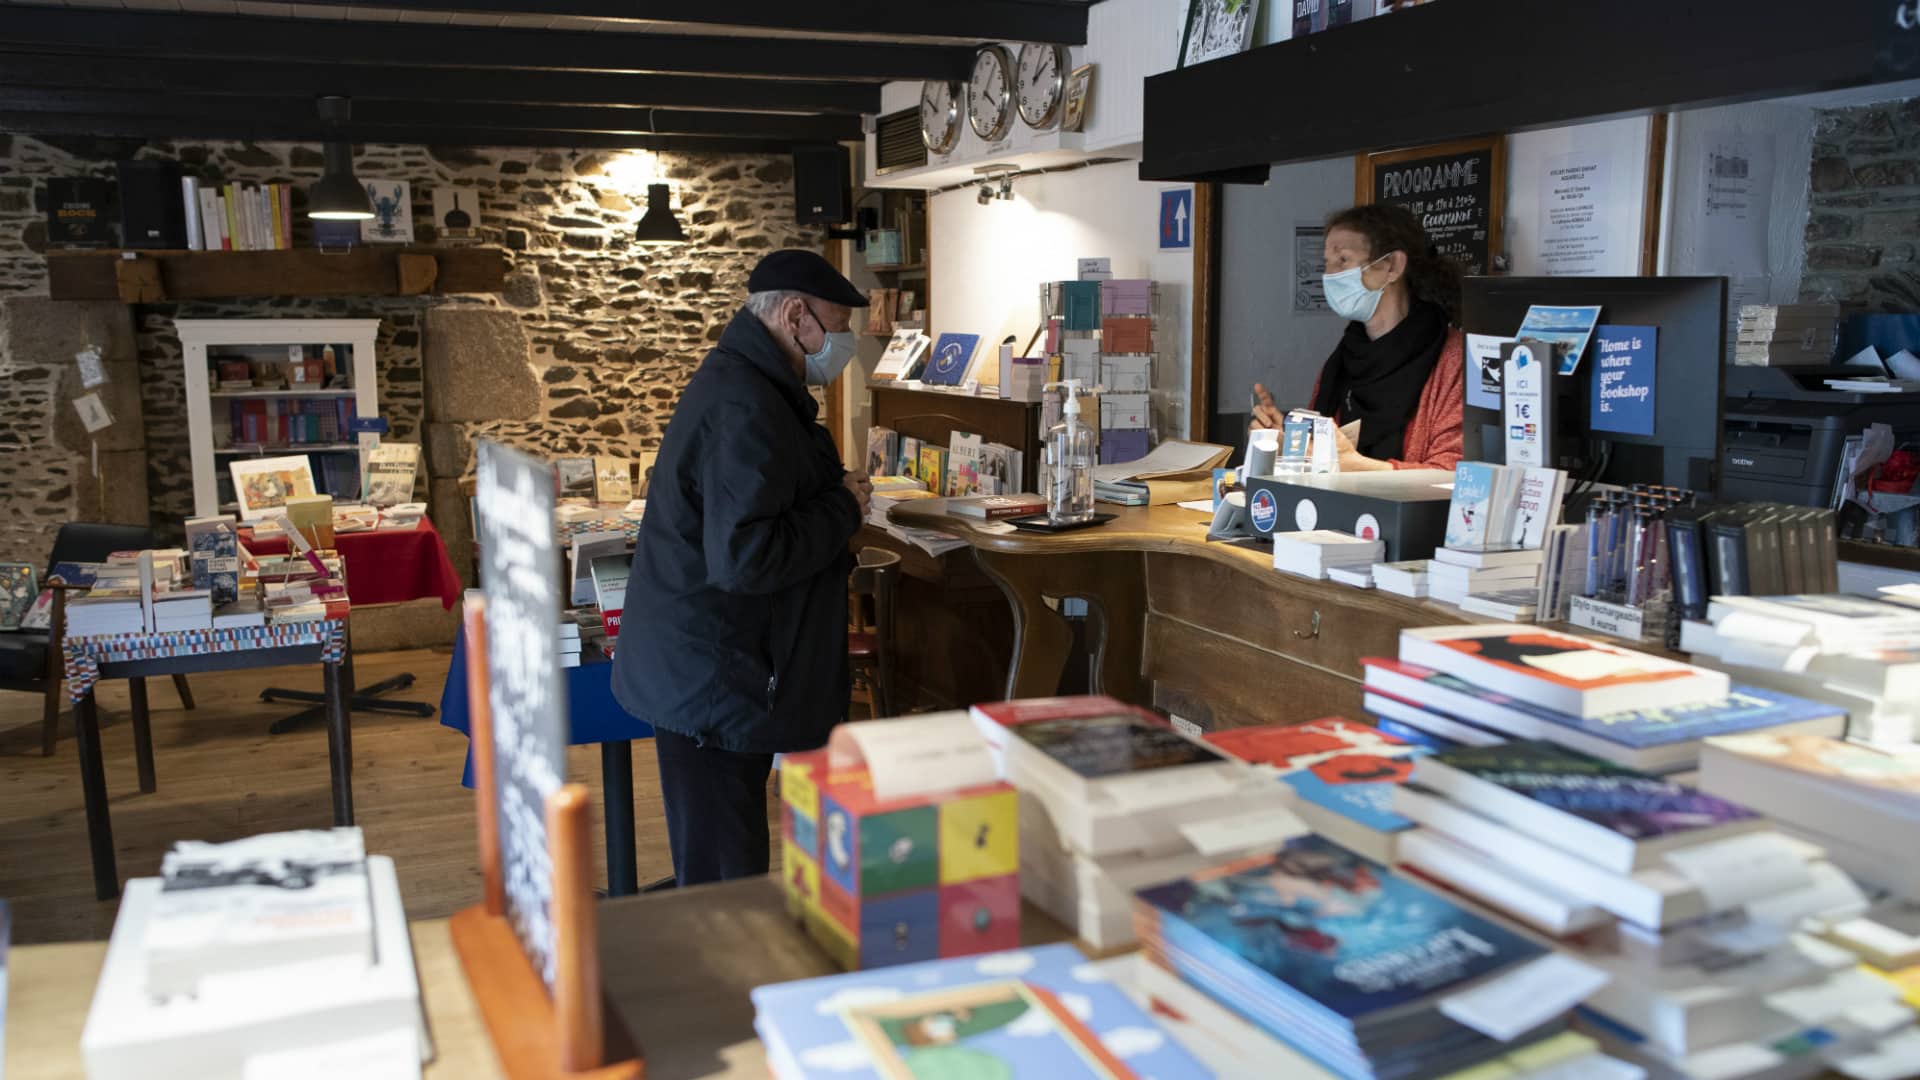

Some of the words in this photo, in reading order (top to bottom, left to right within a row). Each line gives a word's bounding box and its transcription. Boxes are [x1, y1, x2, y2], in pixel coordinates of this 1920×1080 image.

[1297, 0, 1319, 18] DAVID
[1598, 338, 1630, 353] Home
[1631, 337, 1642, 350] is
[1601, 354, 1632, 368] where
[1600, 370, 1625, 386] your
[1600, 384, 1649, 402] bookshop
[1515, 403, 1530, 418] 1€
[1600, 401, 1613, 413] is.
[607, 616, 622, 627] PRI
